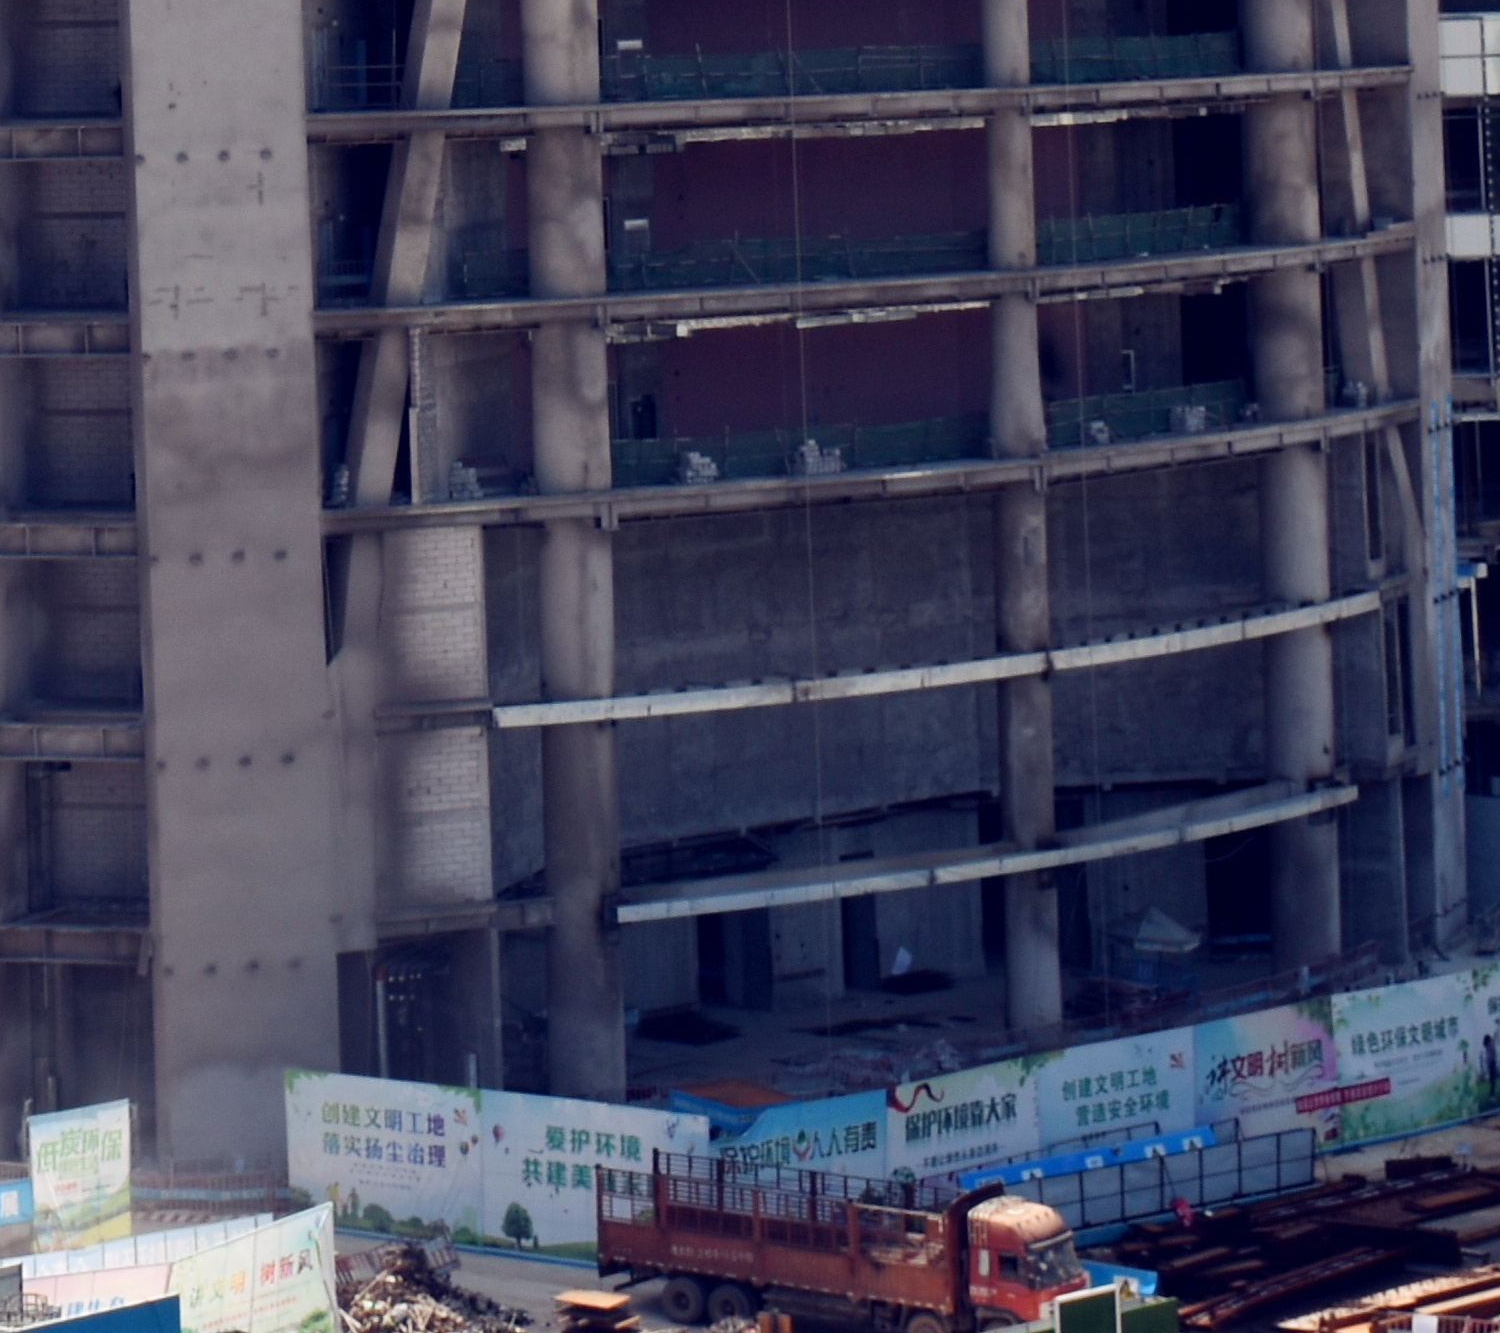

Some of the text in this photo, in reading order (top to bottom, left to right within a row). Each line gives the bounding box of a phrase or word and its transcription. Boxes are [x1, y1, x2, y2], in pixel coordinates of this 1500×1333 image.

[1351, 1015, 1459, 1056] 绿色环保文明城市
[1061, 1064, 1158, 1103] 创建文明工地
[320, 1100, 446, 1138] 创建文明工地
[1075, 1088, 1170, 1128] 营造安全环境
[321, 1130, 447, 1169] 落实扬尘治理
[544, 1124, 643, 1162] 爱护环境
[812, 1119, 878, 1158] 人人有责
